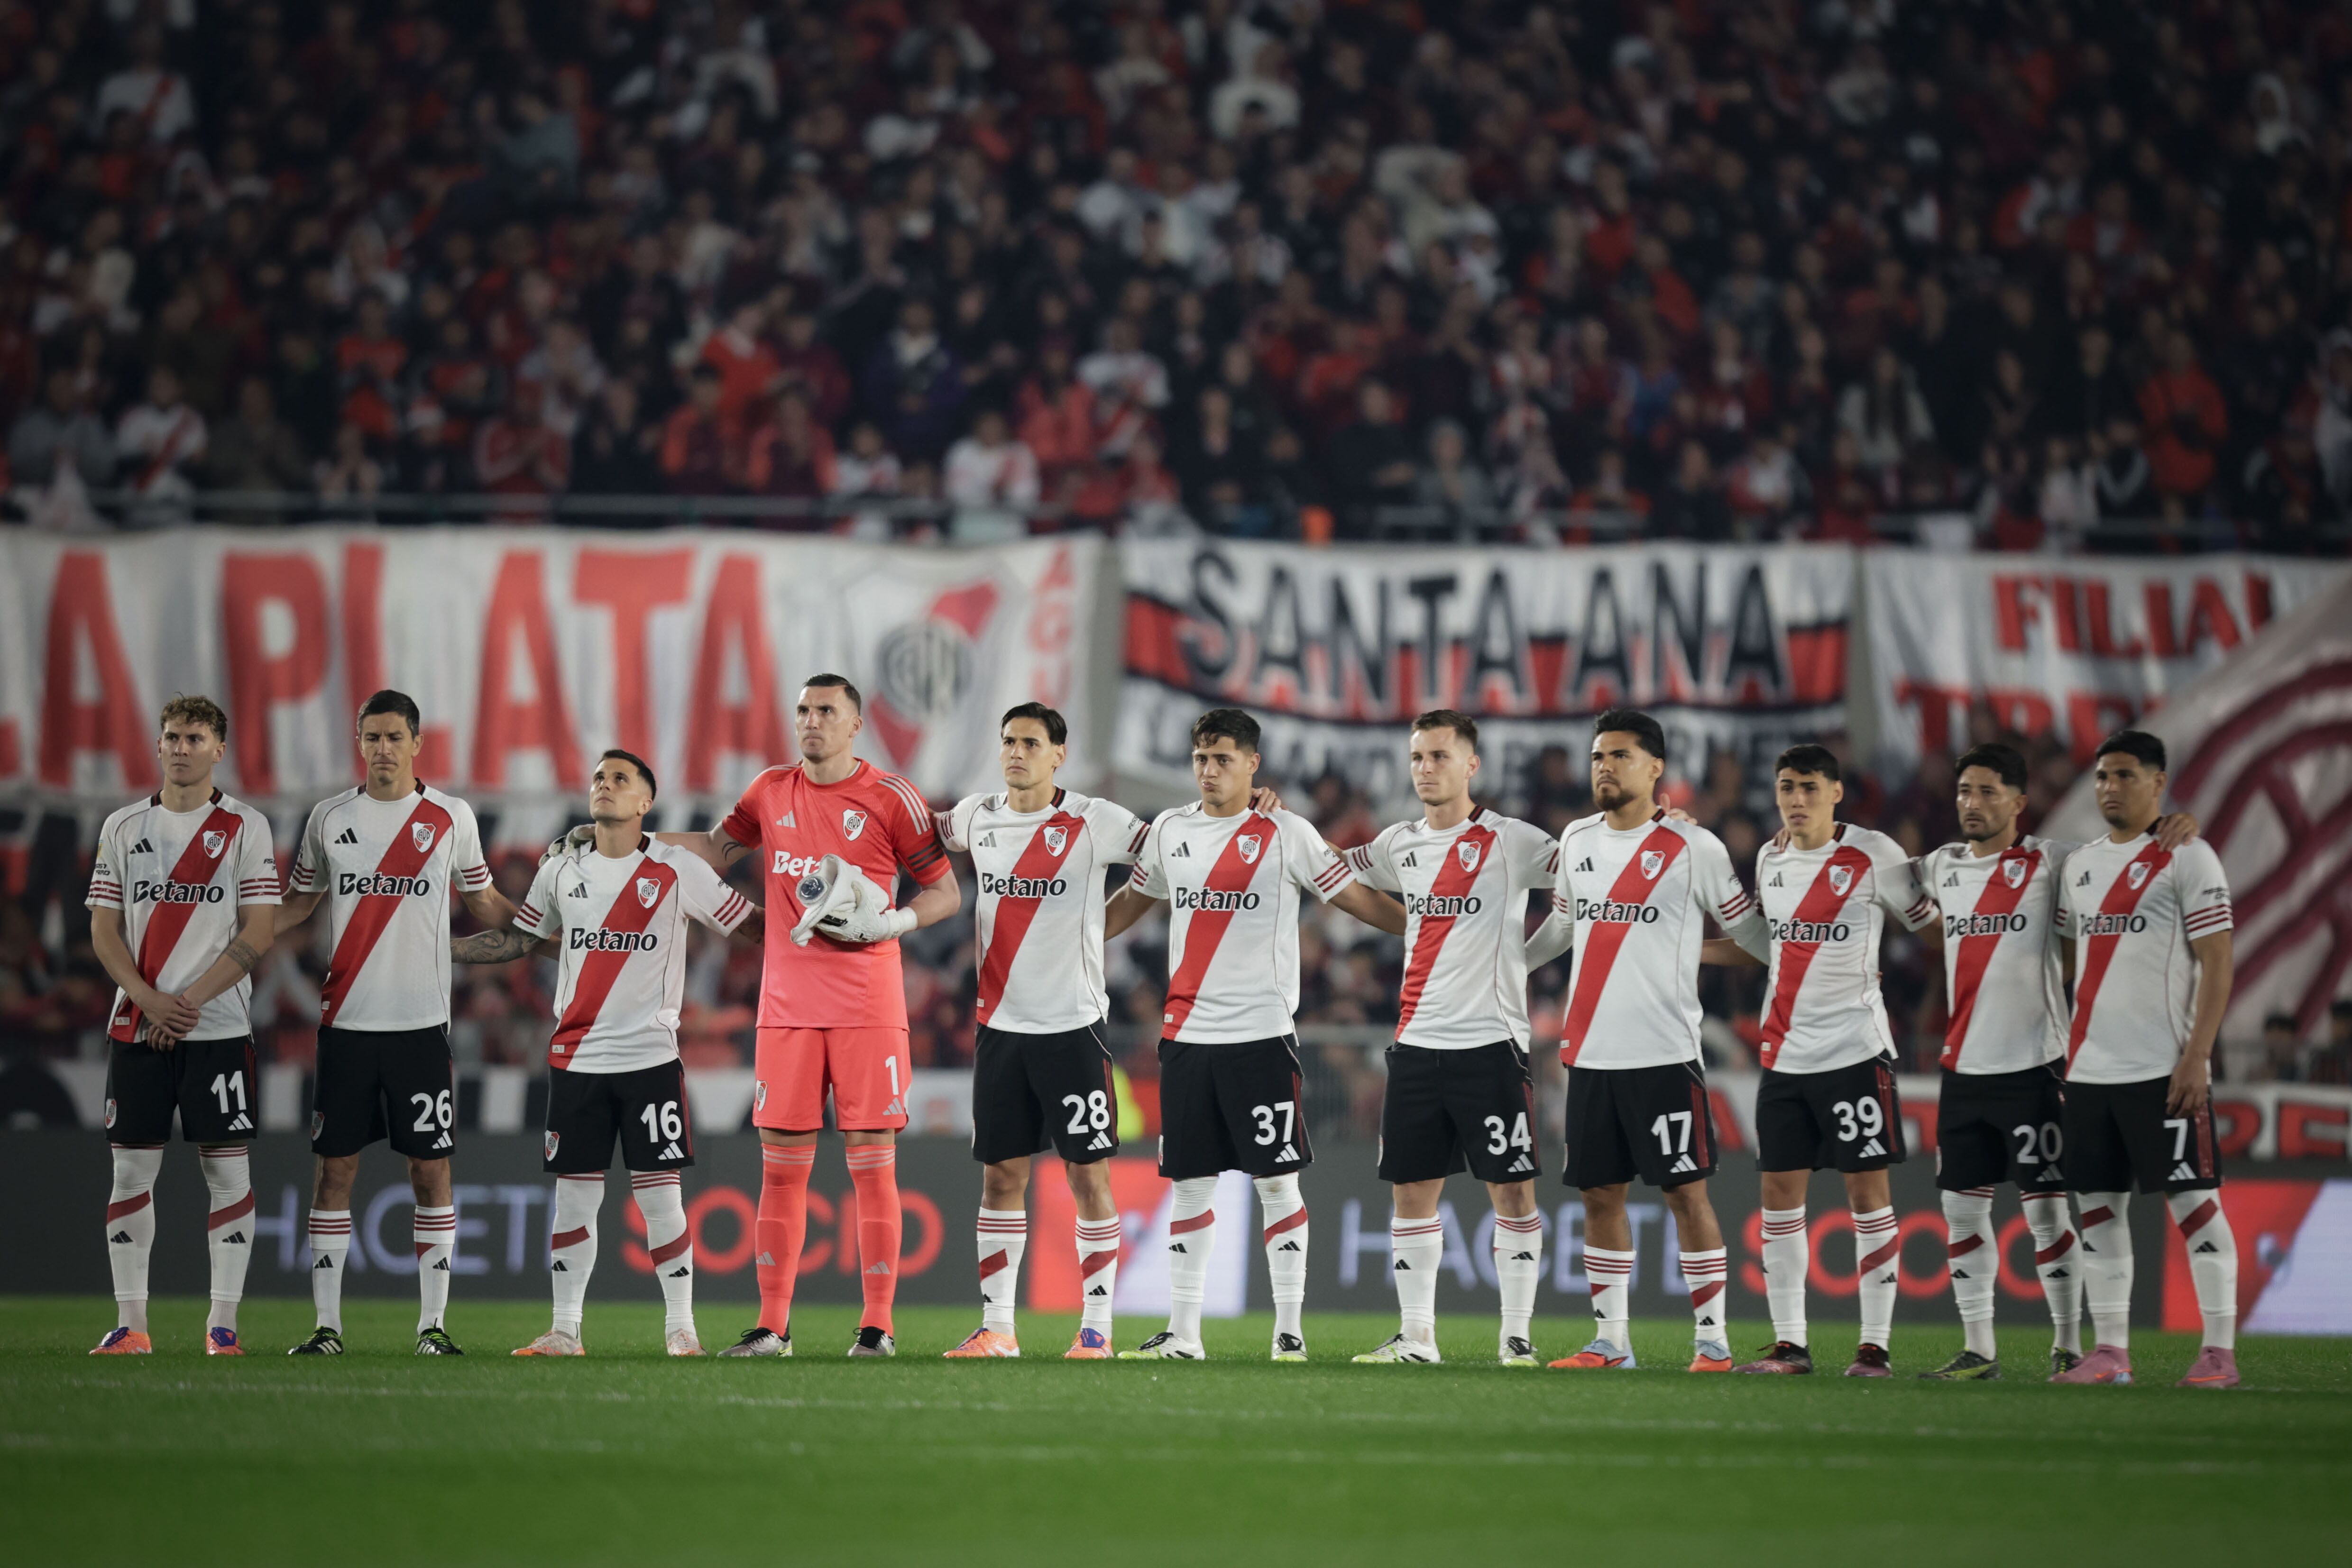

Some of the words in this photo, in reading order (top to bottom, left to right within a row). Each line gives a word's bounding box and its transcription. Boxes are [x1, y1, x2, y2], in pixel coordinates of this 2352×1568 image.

[1182, 551, 1530, 711] SANTA
[1566, 559, 1790, 706] ANA
[219, 541, 787, 796] PLATA
[133, 880, 224, 904] Betano
[339, 873, 430, 896] Betano
[982, 872, 1066, 897] Betano
[1176, 887, 1260, 910] Betano
[1577, 899, 1659, 923] Betano
[570, 928, 658, 951] Betano
[211, 1071, 247, 1113] 11
[885, 1055, 899, 1095] 1
[410, 1090, 453, 1132] 26
[640, 1100, 682, 1143] 16
[1062, 1090, 1110, 1134] 28
[1251, 1100, 1295, 1146] 37
[1832, 1096, 1883, 1142] 39
[1484, 1112, 1532, 1155] 34
[1650, 1110, 1692, 1155] 17
[2012, 1122, 2062, 1164] 20
[2163, 1119, 2188, 1161] 7
